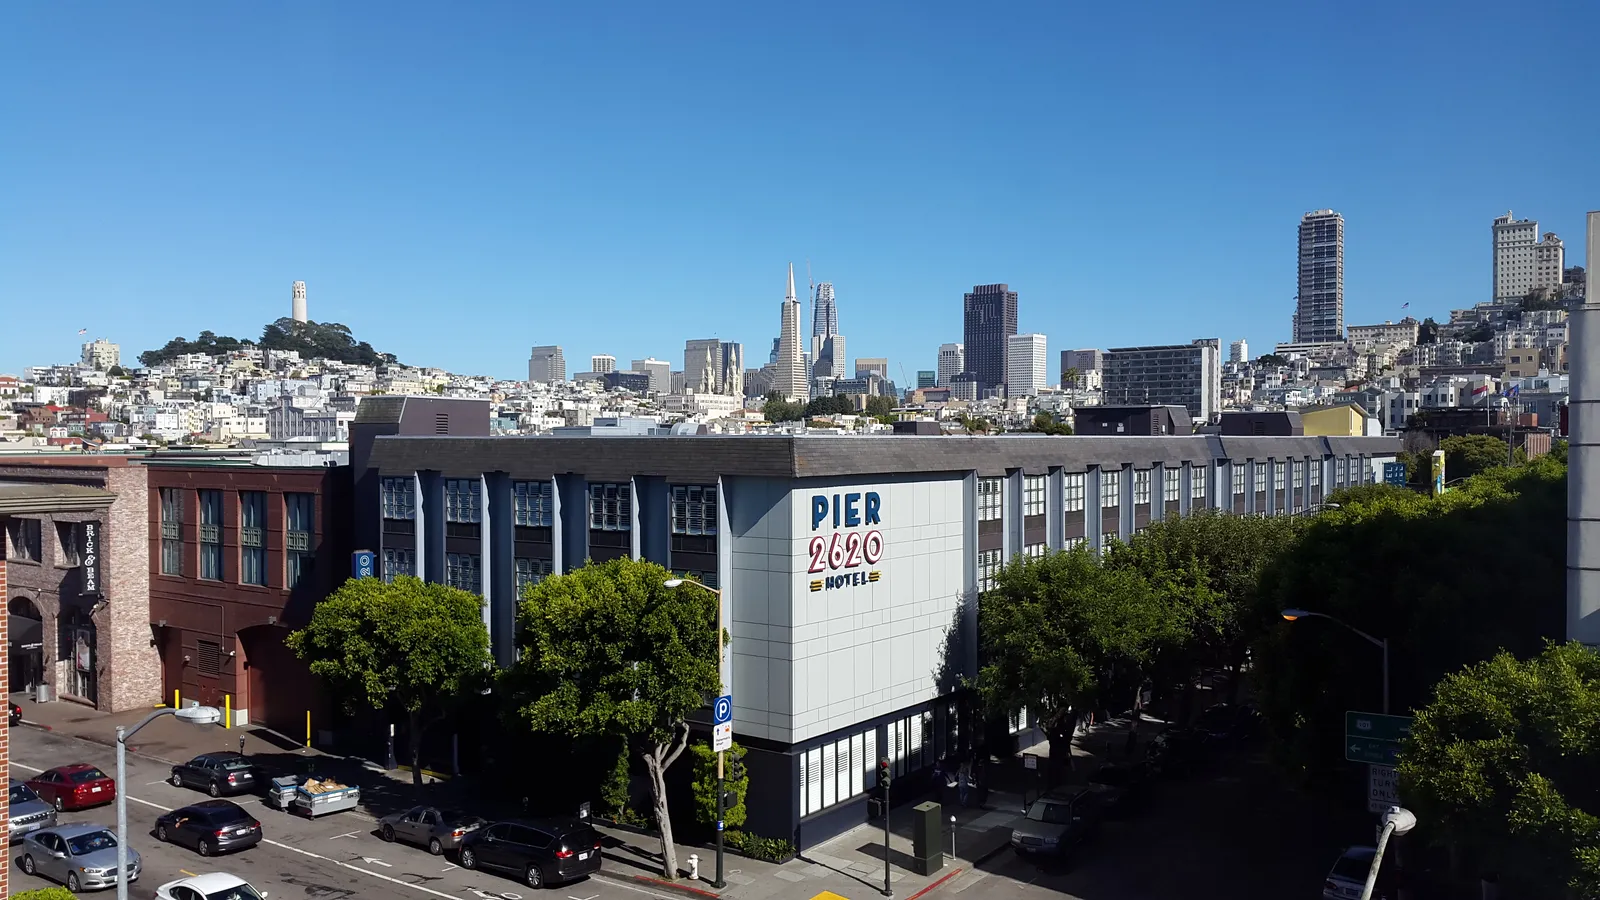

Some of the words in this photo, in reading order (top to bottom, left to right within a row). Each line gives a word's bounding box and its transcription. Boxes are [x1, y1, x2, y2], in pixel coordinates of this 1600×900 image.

[812, 491, 881, 531] PIER
[86, 524, 95, 554] BRICK
[84, 554, 96, 567] &
[807, 530, 884, 574] 2620
[86, 567, 95, 591] BEAM
[825, 571, 869, 591] HOTEL
[720, 702, 728, 718] P
[1372, 789, 1397, 799] ONLY
